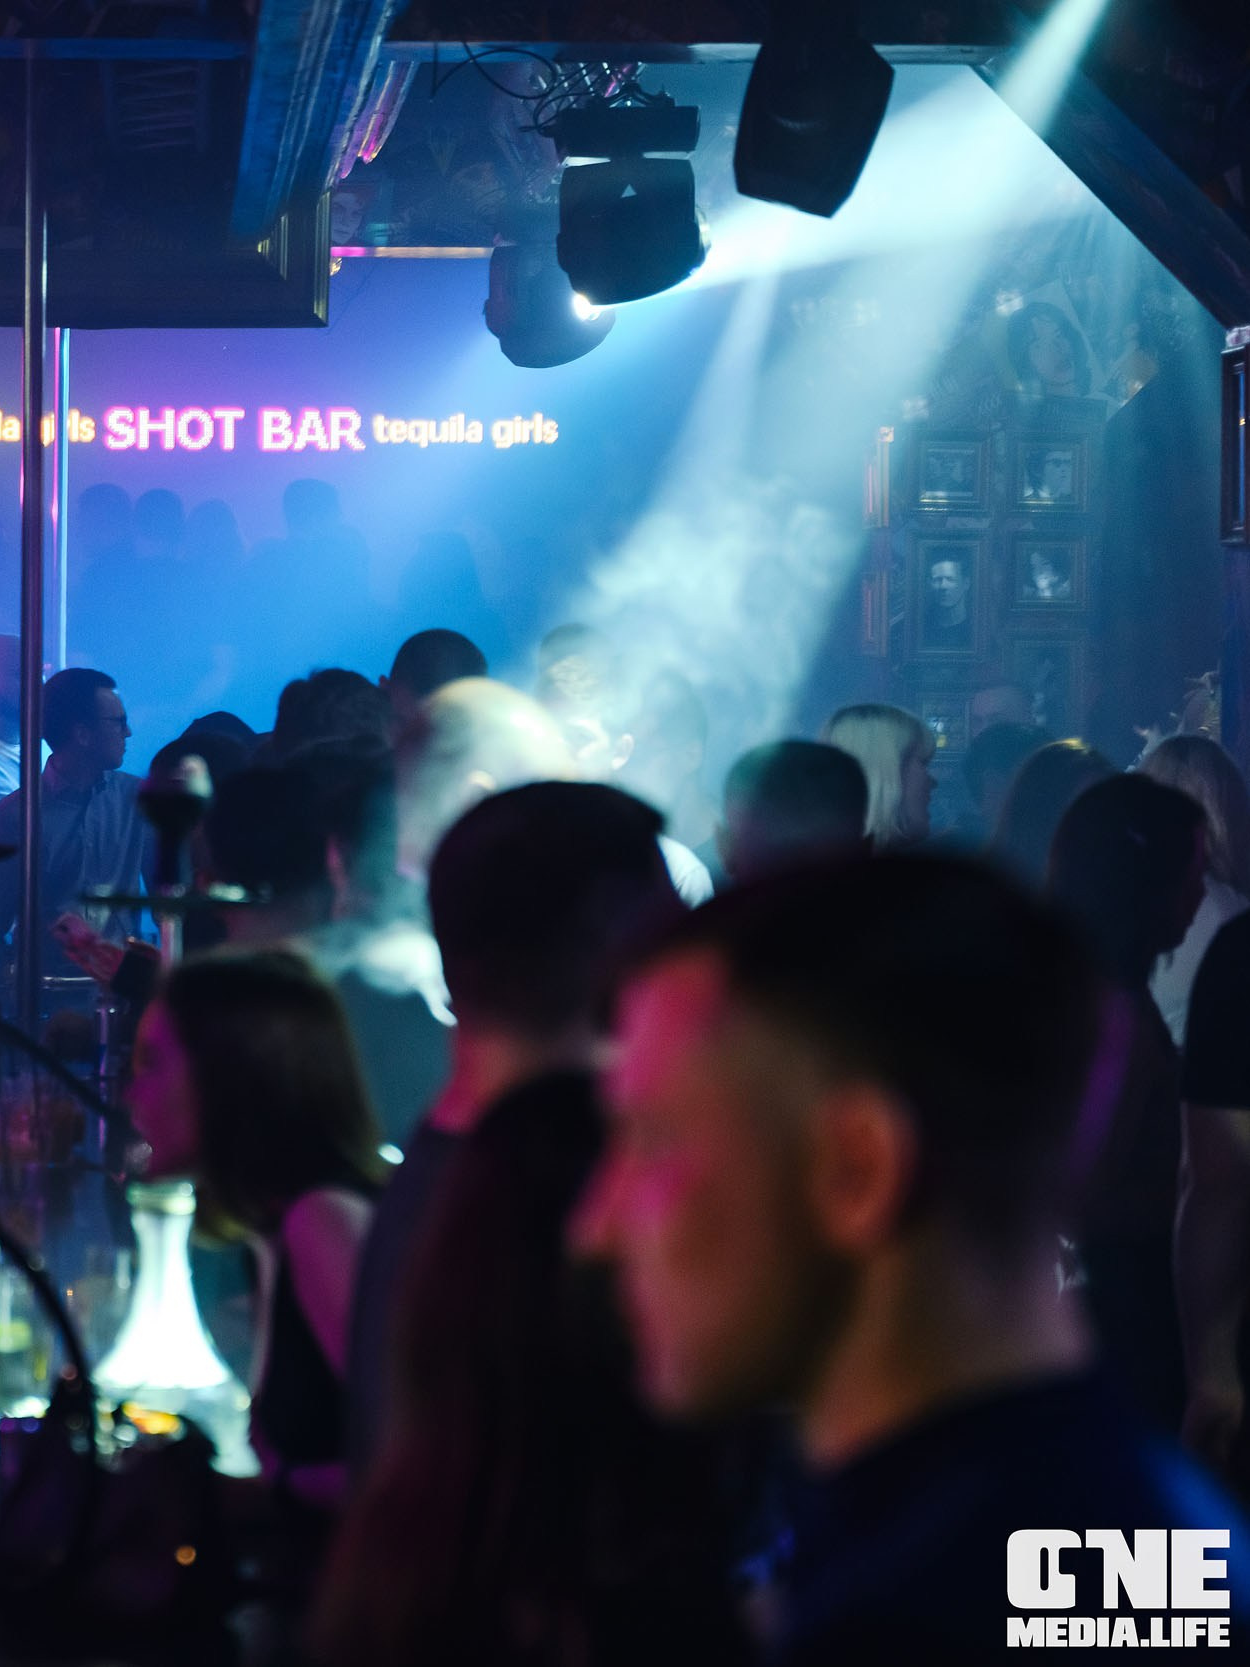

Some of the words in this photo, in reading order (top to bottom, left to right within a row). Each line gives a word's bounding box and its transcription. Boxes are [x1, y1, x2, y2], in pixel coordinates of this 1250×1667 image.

[104, 406, 245, 451] SHOT
[259, 406, 366, 451] BAR
[373, 412, 483, 448] tequila
[492, 412, 558, 448] girls
